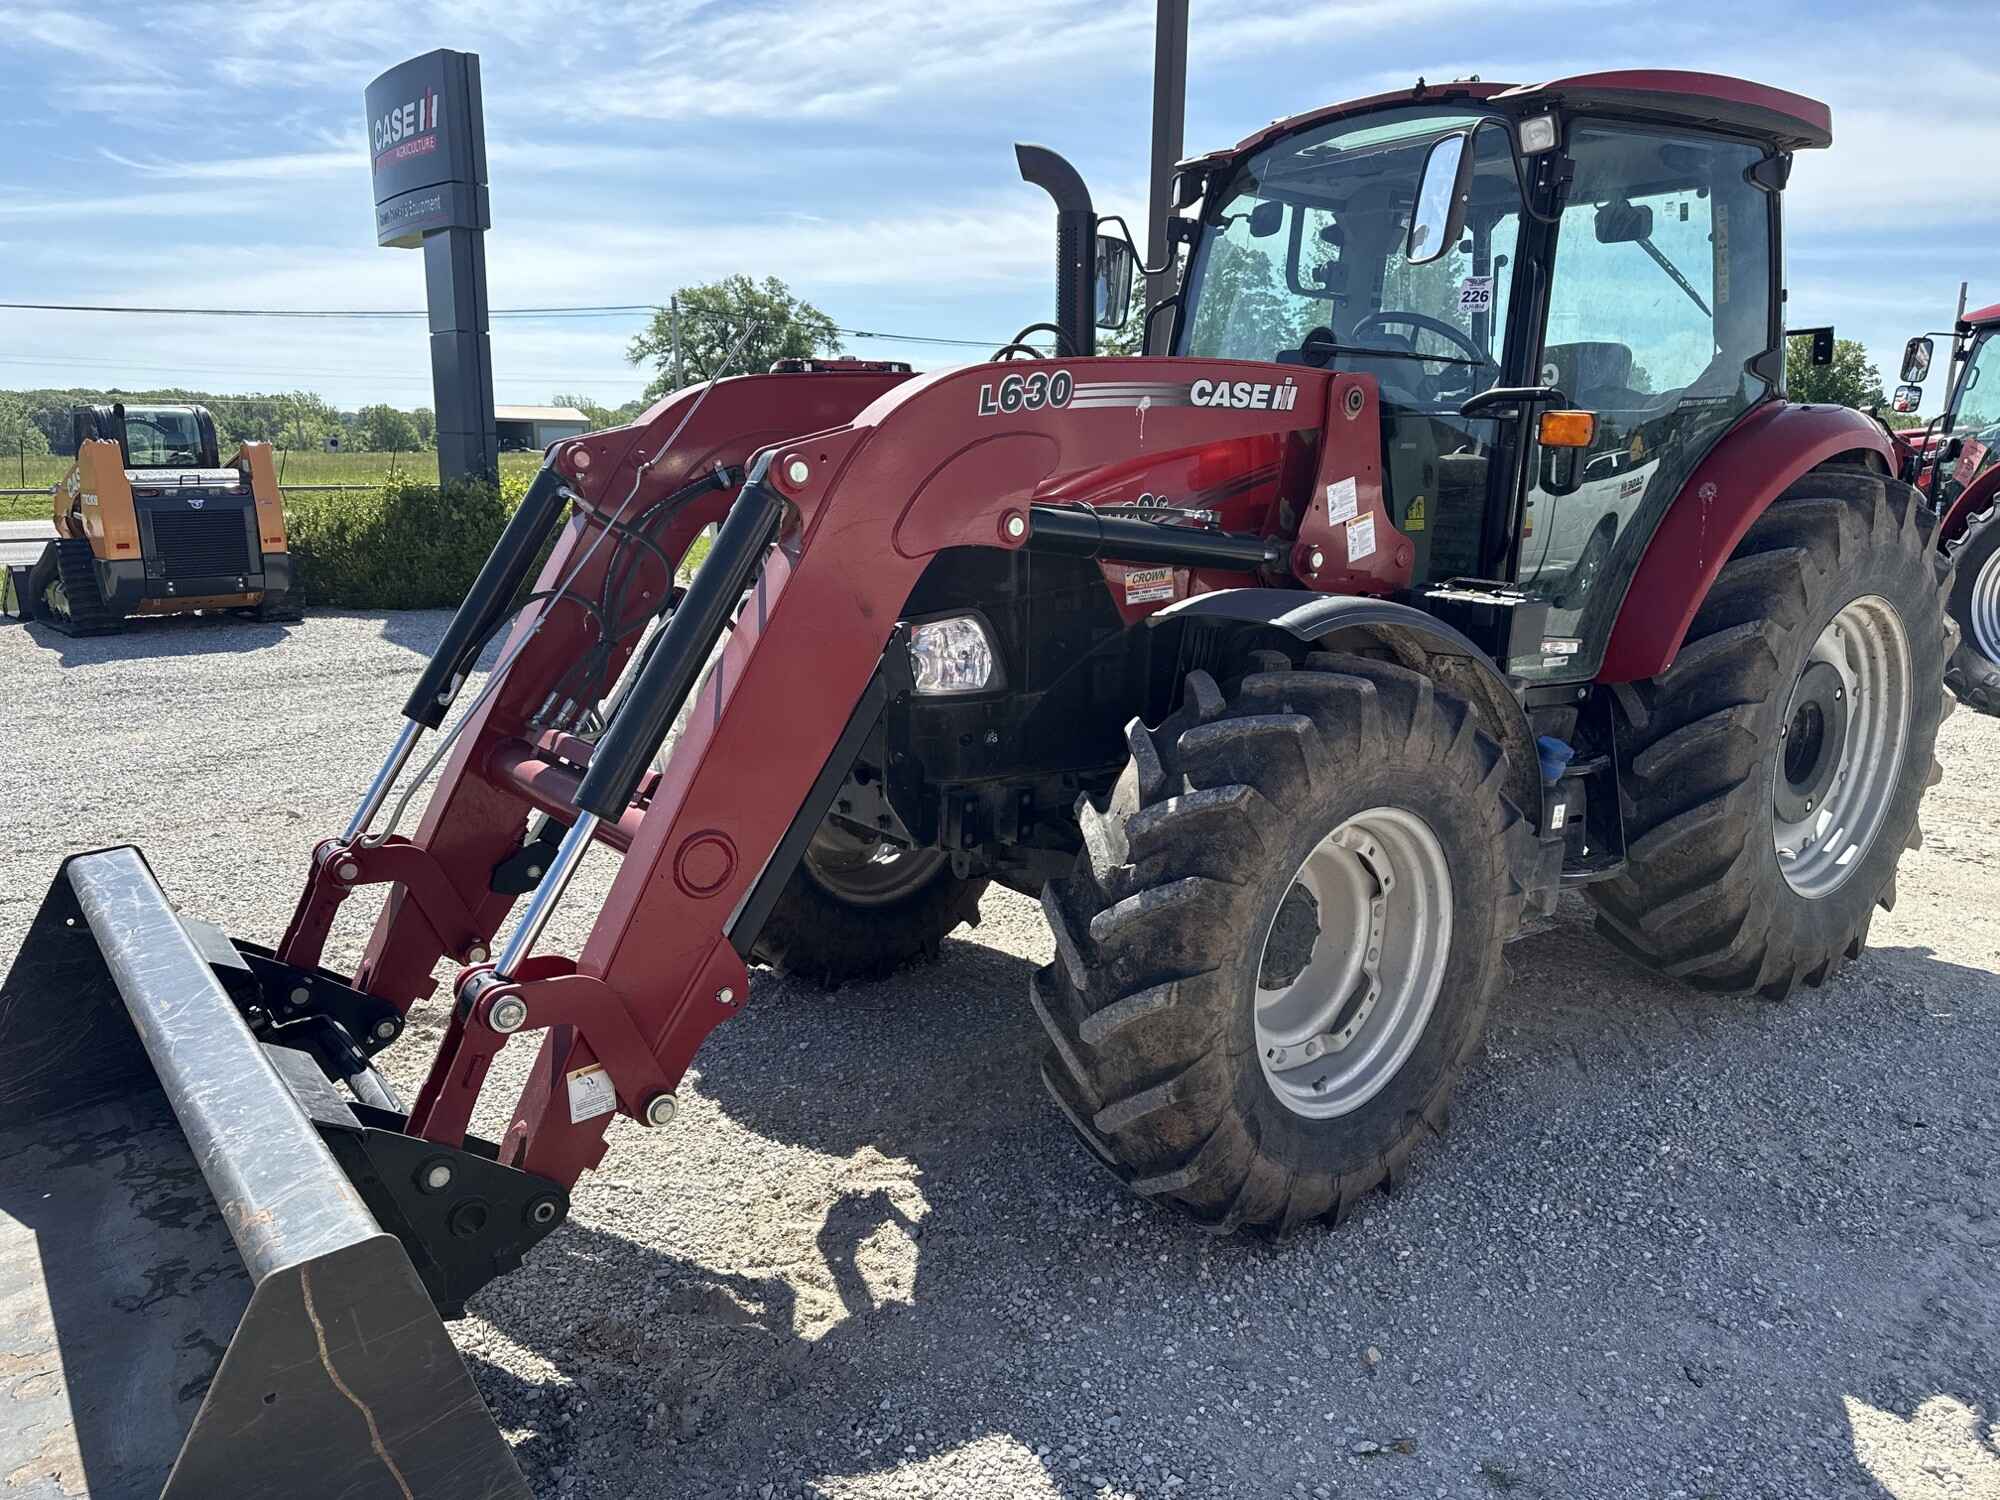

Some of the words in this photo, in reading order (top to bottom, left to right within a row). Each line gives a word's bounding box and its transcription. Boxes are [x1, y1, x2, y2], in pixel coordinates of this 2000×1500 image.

[374, 102, 415, 151] CASE
[1461, 290, 1489, 304] 226
[978, 370, 1073, 416] L630
[1190, 379, 1272, 410] CASE
[1132, 570, 1167, 585] CROWN
